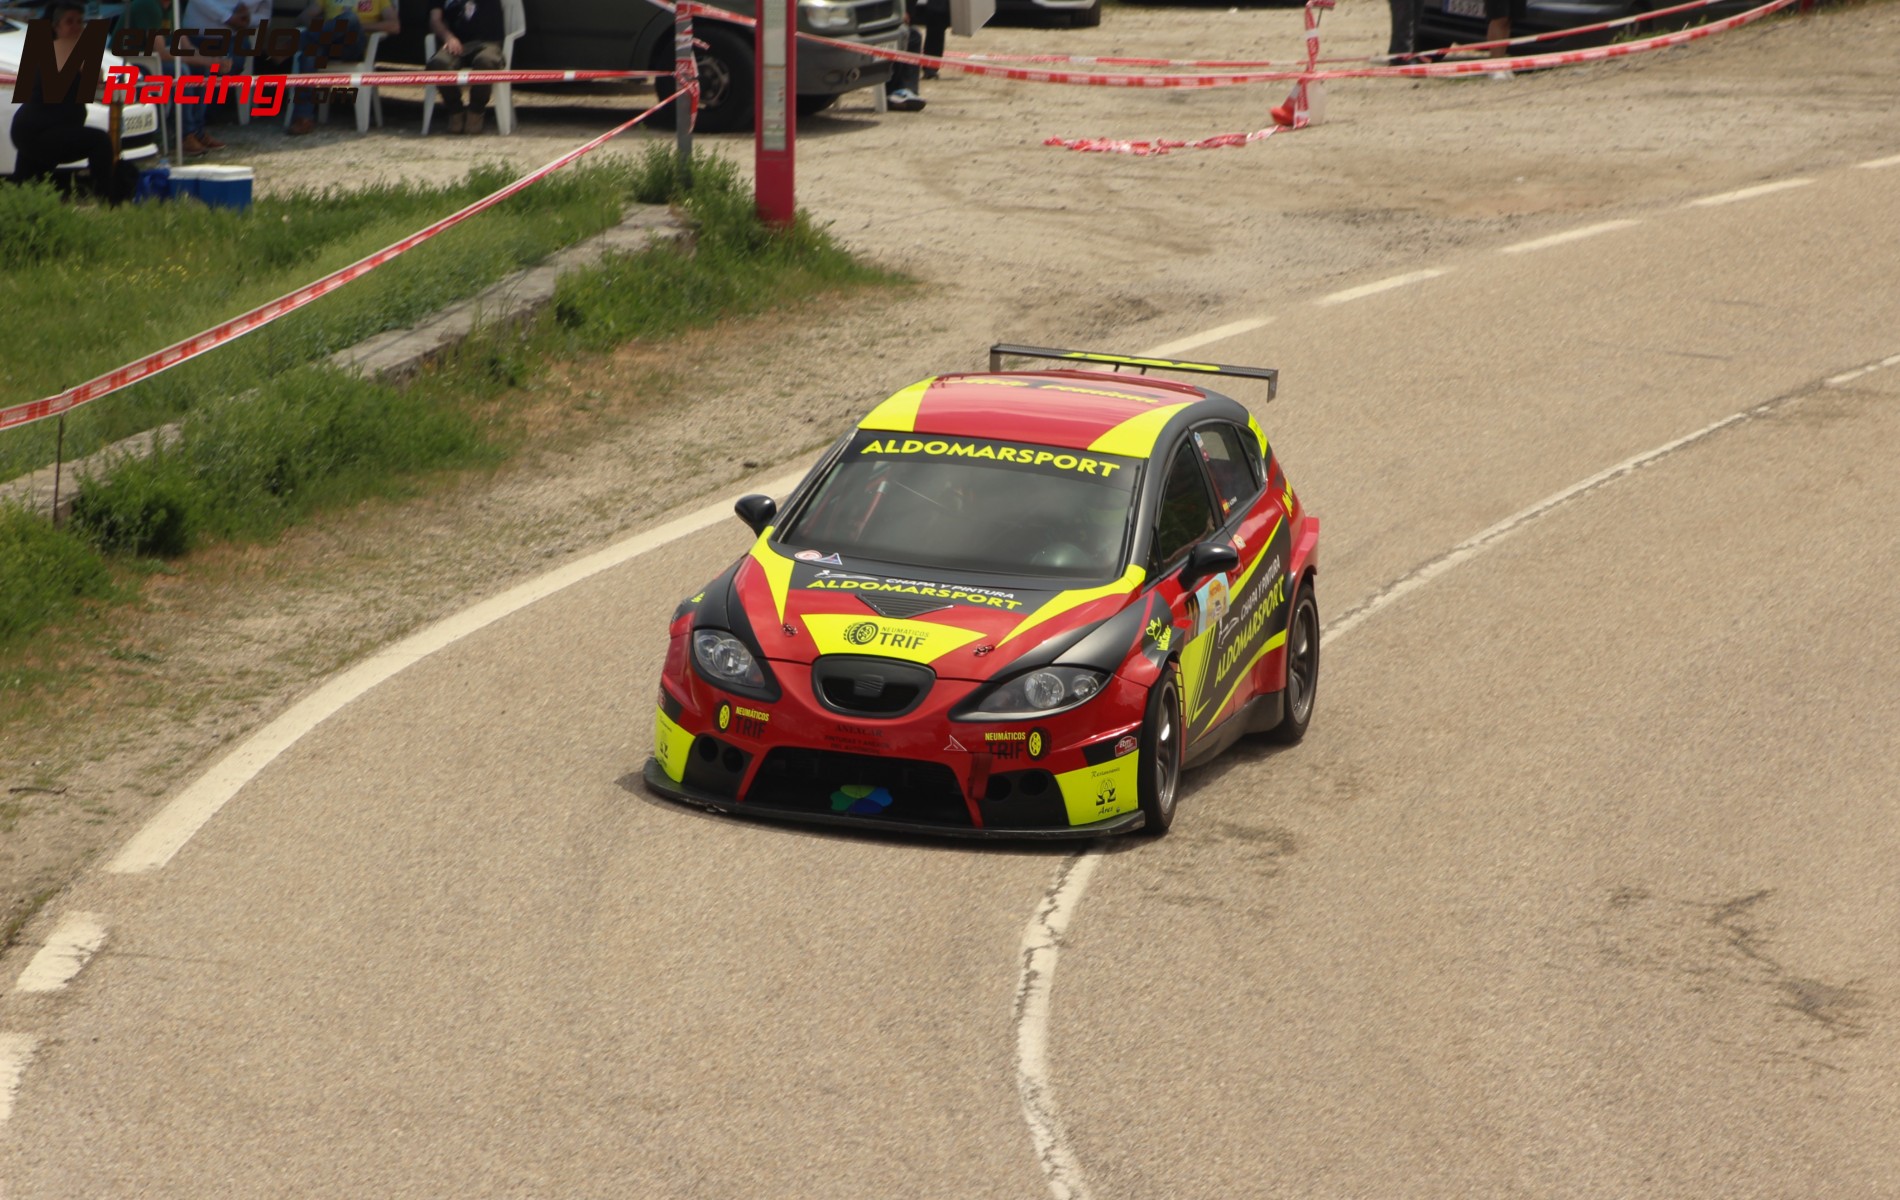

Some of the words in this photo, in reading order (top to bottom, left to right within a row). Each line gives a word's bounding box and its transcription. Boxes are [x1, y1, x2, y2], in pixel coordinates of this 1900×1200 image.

[861, 439, 1120, 478] ALDOMARSPORT
[806, 579, 1022, 610] ALDOMARSPORT
[886, 578, 936, 588] CHAPA
[950, 585, 1014, 600] PINTURA
[880, 632, 926, 650] TRIF
[1214, 573, 1285, 689] ALDOMARSPORT
[735, 706, 770, 722] NEUMÁTICOS
[735, 715, 767, 739] TRIF
[984, 731, 1026, 741] NEUMÁTICOS
[985, 741, 1024, 760] TRIF
